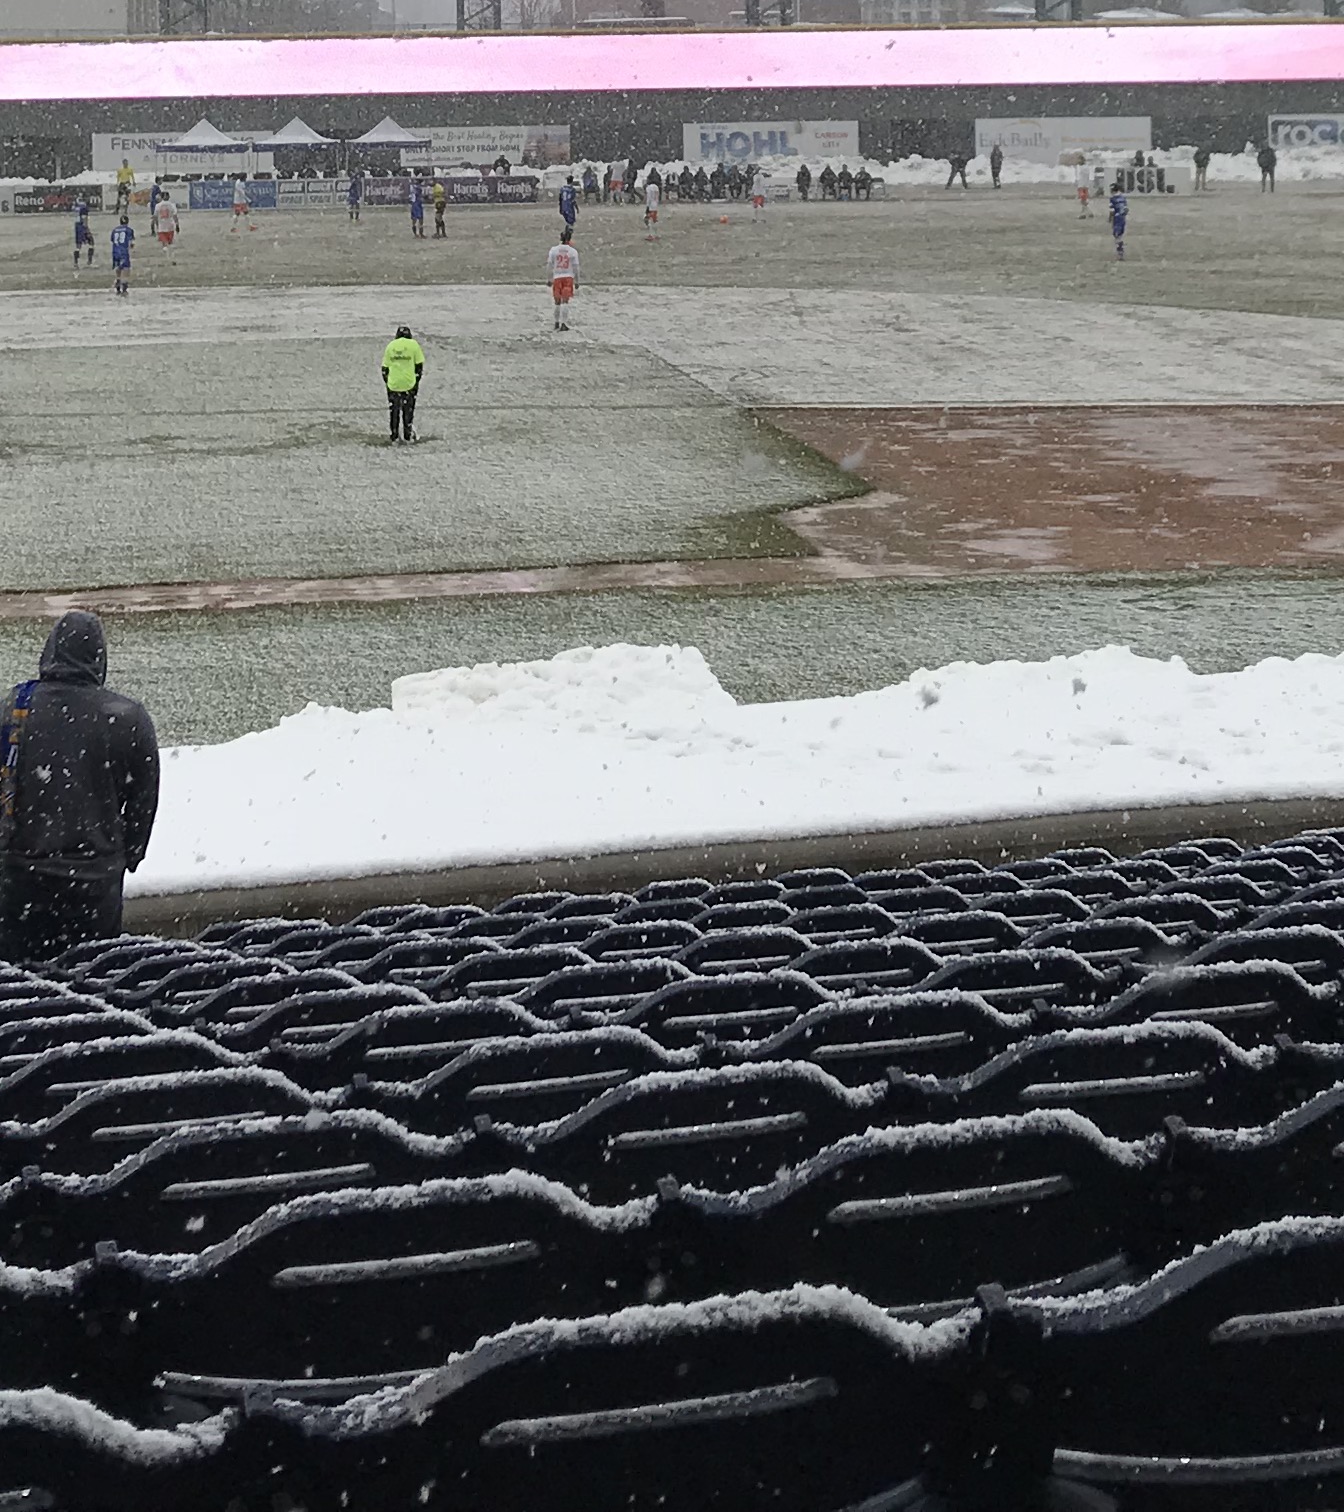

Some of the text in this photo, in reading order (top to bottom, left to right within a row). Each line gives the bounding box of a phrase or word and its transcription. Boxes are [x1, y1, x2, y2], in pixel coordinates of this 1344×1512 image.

[432, 145, 455, 154] SHORT
[456, 145, 474, 153] STOP
[476, 144, 497, 153] FROM
[699, 130, 799, 158] HOHL
[143, 152, 225, 165] ATTORNEYS
[556, 254, 570, 269] 23
